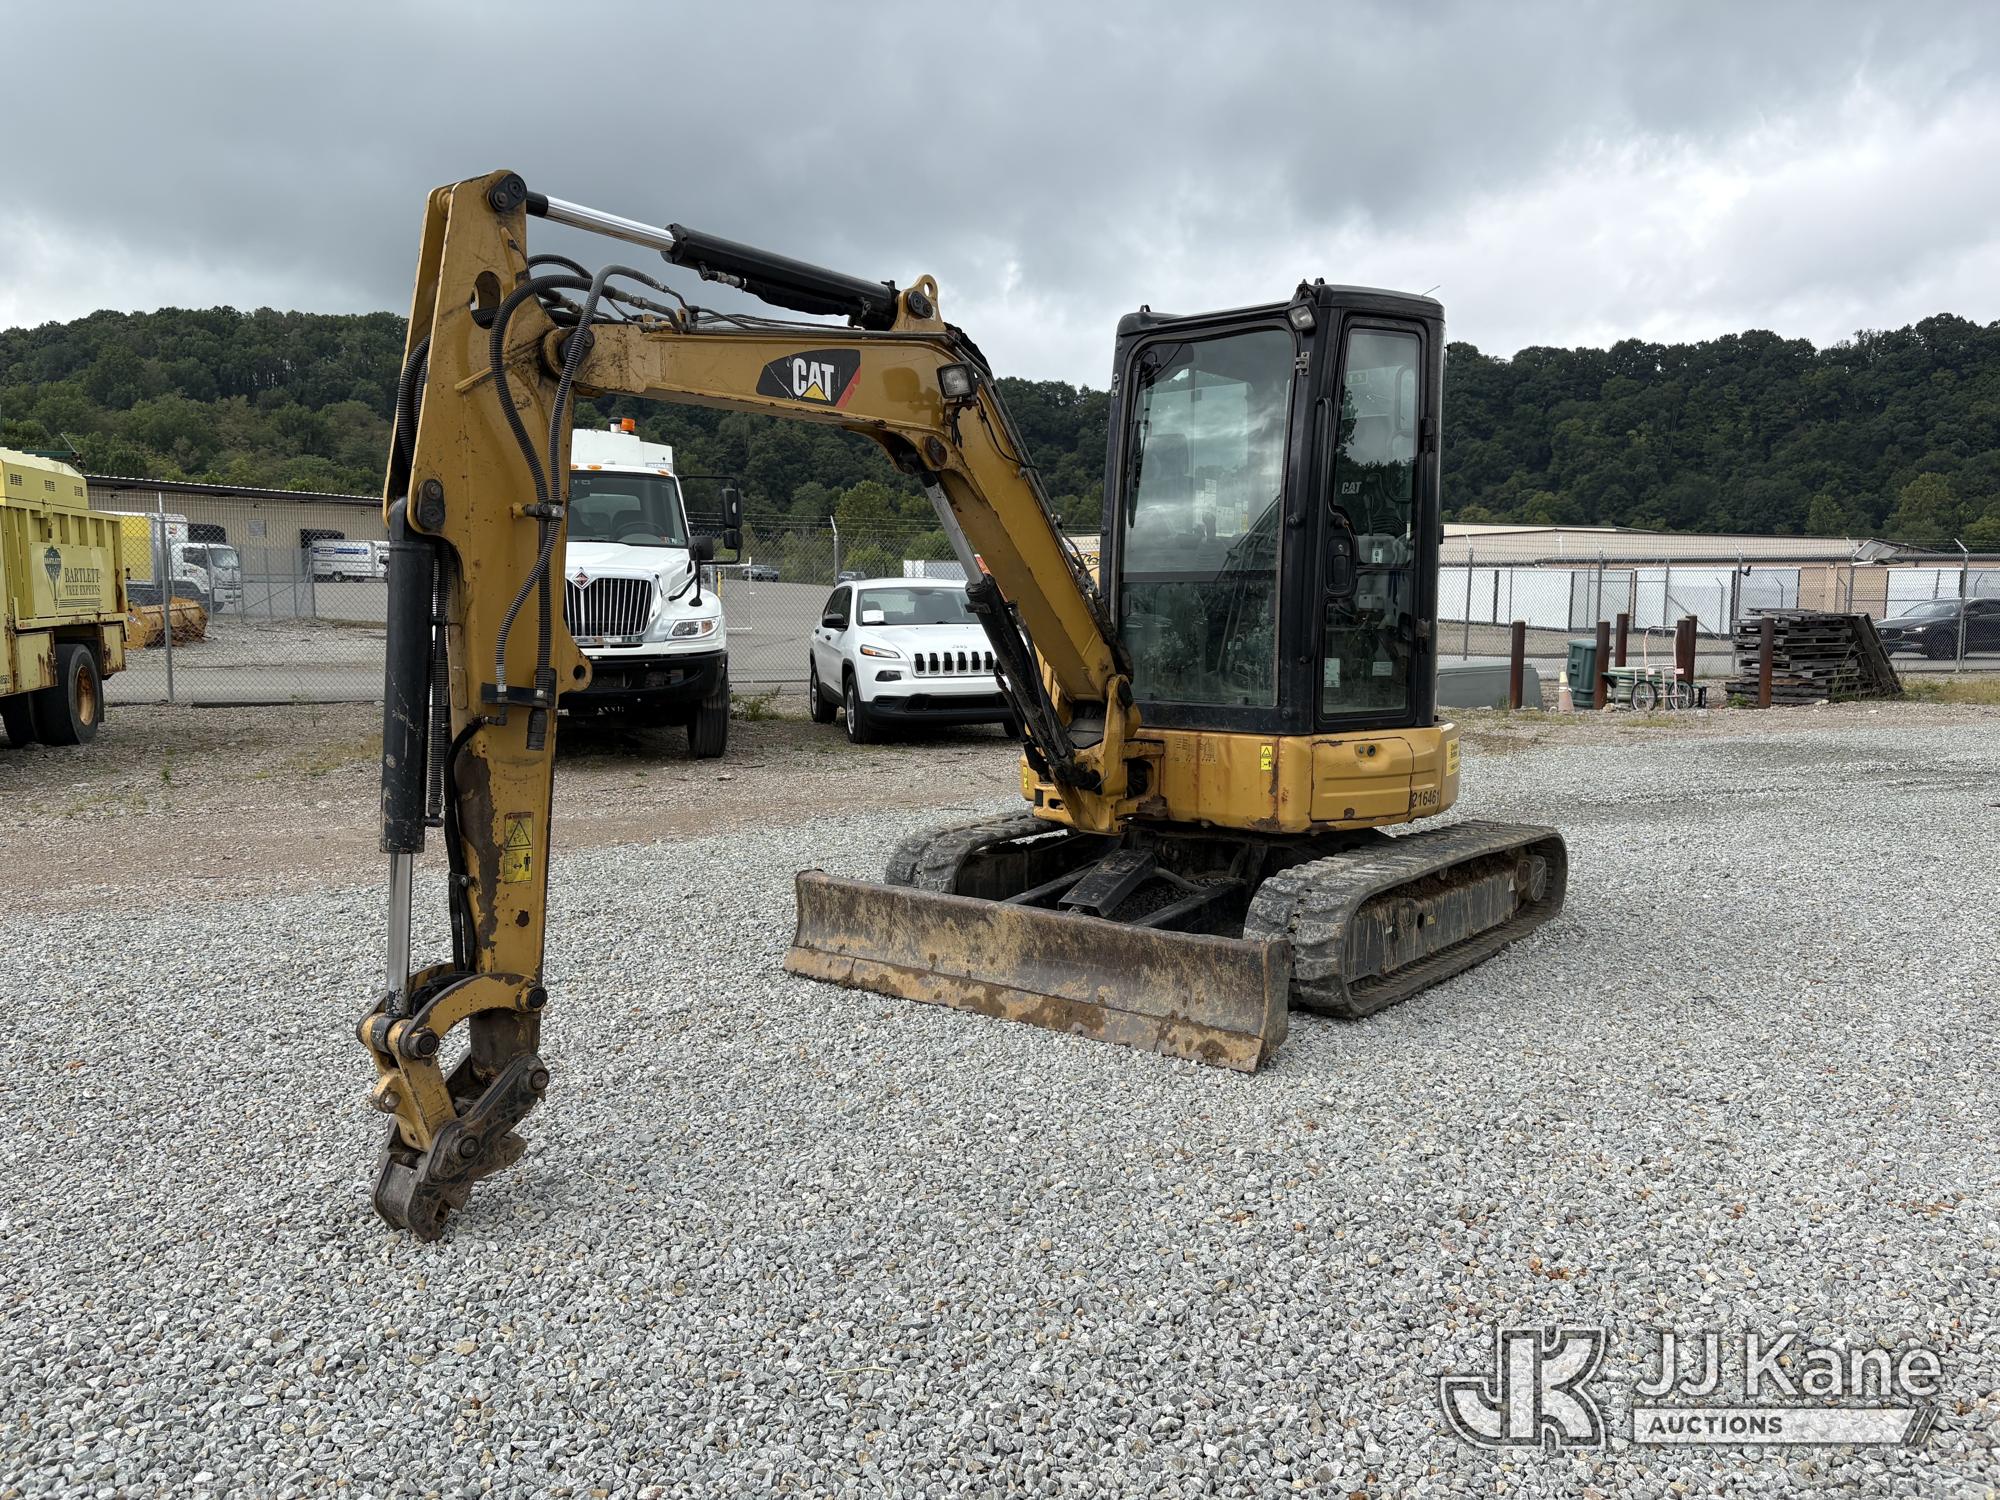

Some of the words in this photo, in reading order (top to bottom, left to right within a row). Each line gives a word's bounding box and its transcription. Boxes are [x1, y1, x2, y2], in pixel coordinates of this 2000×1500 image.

[792, 358, 835, 401] CAT
[1341, 481, 1362, 494] CAT
[64, 567, 100, 583] BARTLETT
[65, 584, 79, 596] TREE
[80, 584, 101, 596] EXPERTS
